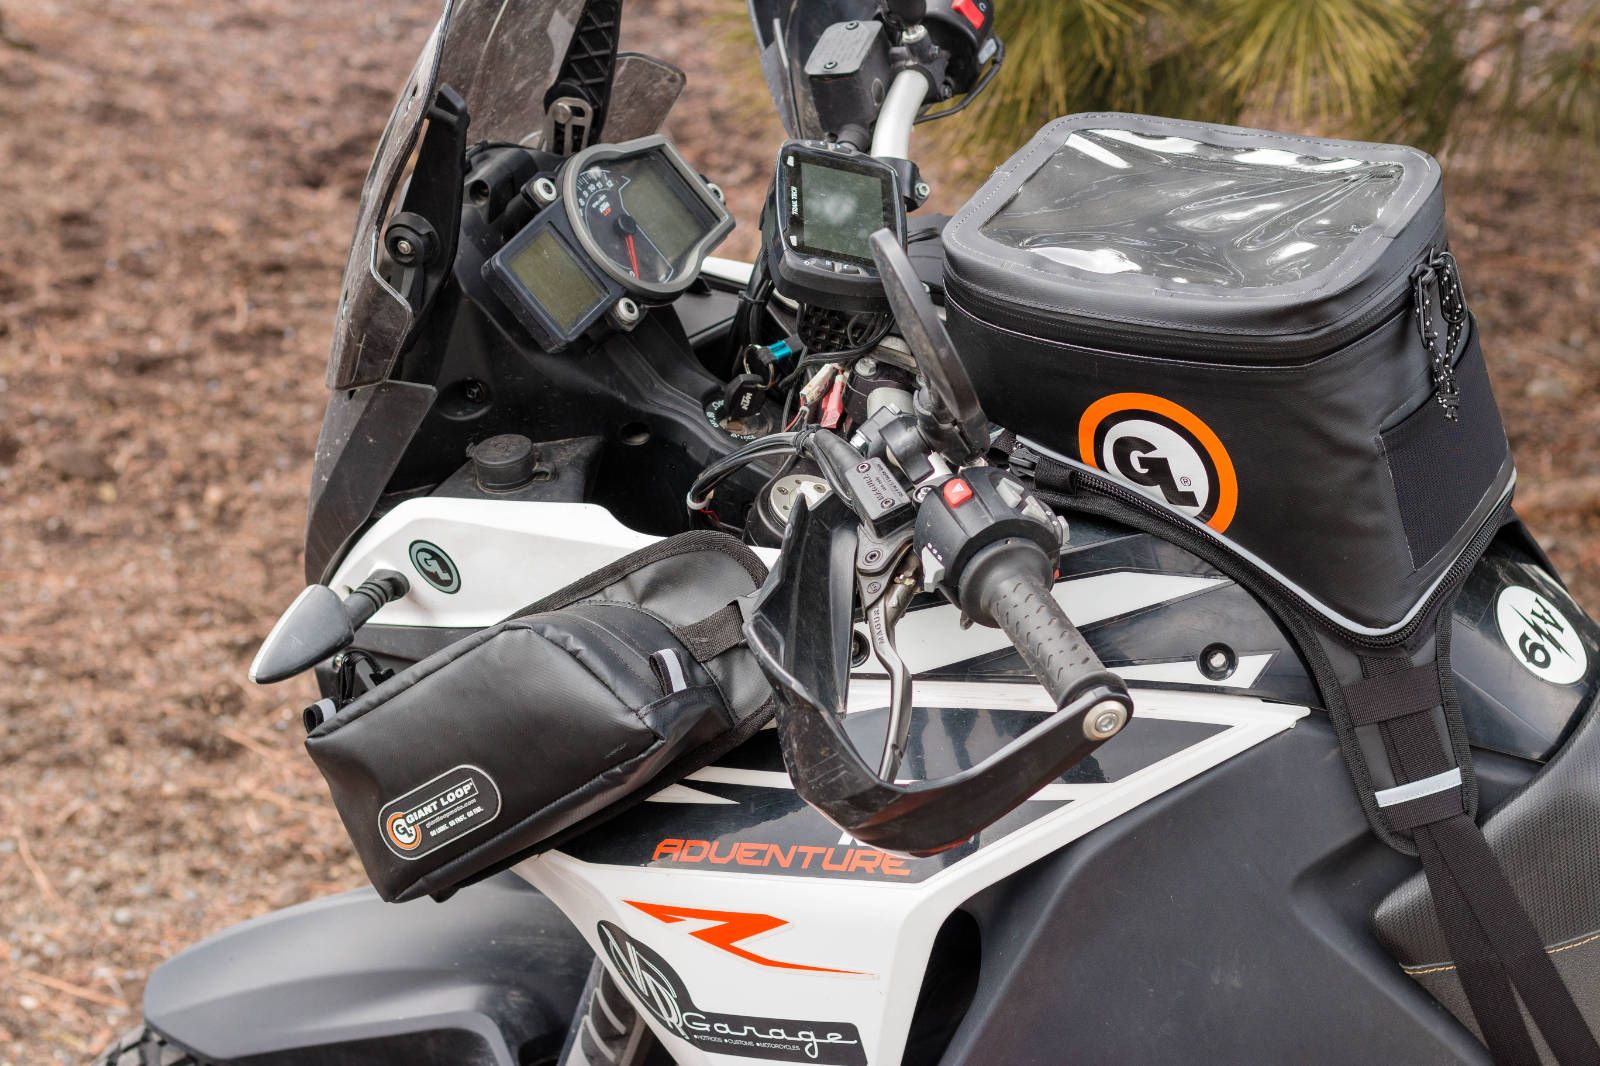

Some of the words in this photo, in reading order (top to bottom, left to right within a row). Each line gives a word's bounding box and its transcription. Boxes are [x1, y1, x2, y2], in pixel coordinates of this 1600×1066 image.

[405, 801, 438, 825] GIANT
[440, 783, 472, 806] LOOP
[652, 838, 912, 876] ADVENTURE
[681, 1011, 858, 1059] Garage
